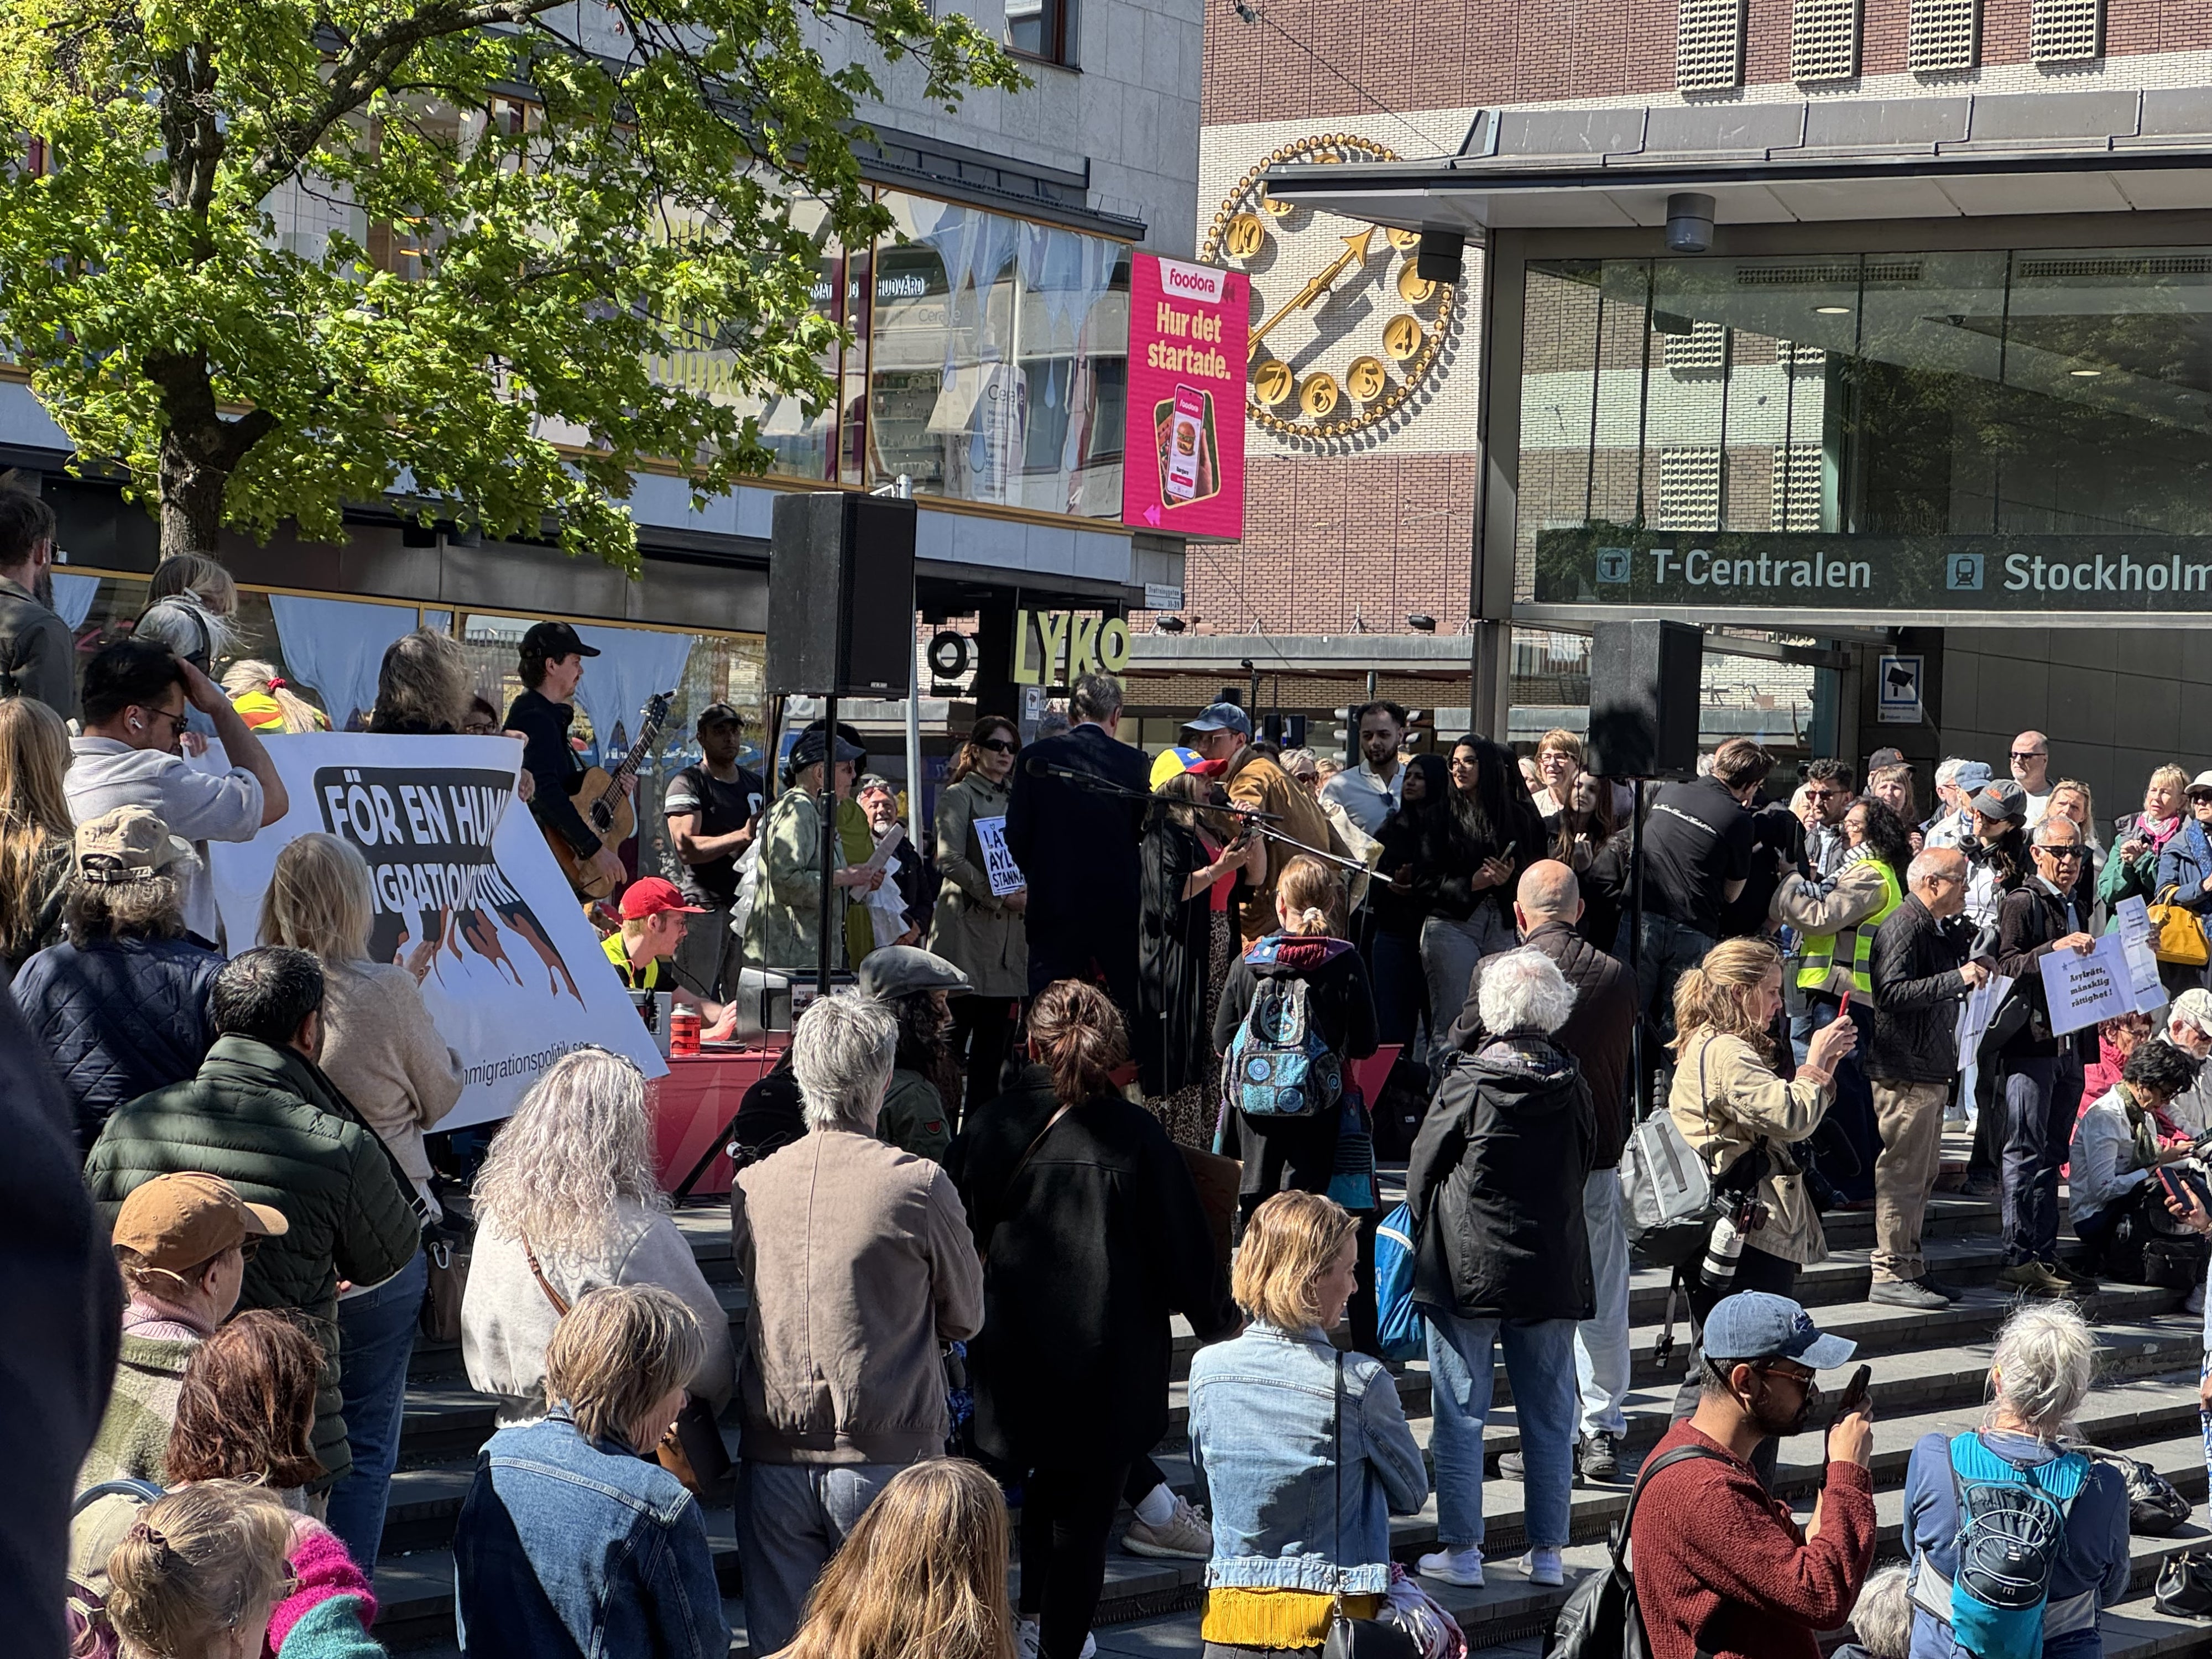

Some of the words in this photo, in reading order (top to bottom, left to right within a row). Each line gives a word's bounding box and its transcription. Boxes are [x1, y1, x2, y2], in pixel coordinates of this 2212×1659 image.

[1233, 220, 1261, 253] 10
[877, 275, 925, 298] HUDVÅRD
[1169, 268, 1215, 294] foodora
[1156, 301, 1190, 337] Hur
[1191, 309, 1222, 344] det
[1392, 319, 1410, 352] 4
[1147, 339, 1232, 380] startade.
[1179, 399, 1199, 413] foodora
[1649, 548, 1870, 589] T-Centralen
[1013, 609, 1131, 687] LYKO
[324, 769, 404, 847] FÖR
[399, 785, 452, 845] EN
[989, 849, 1016, 872] AYL
[2069, 966, 2106, 983] Asylrätt,
[2070, 978, 2110, 995] mänsklig
